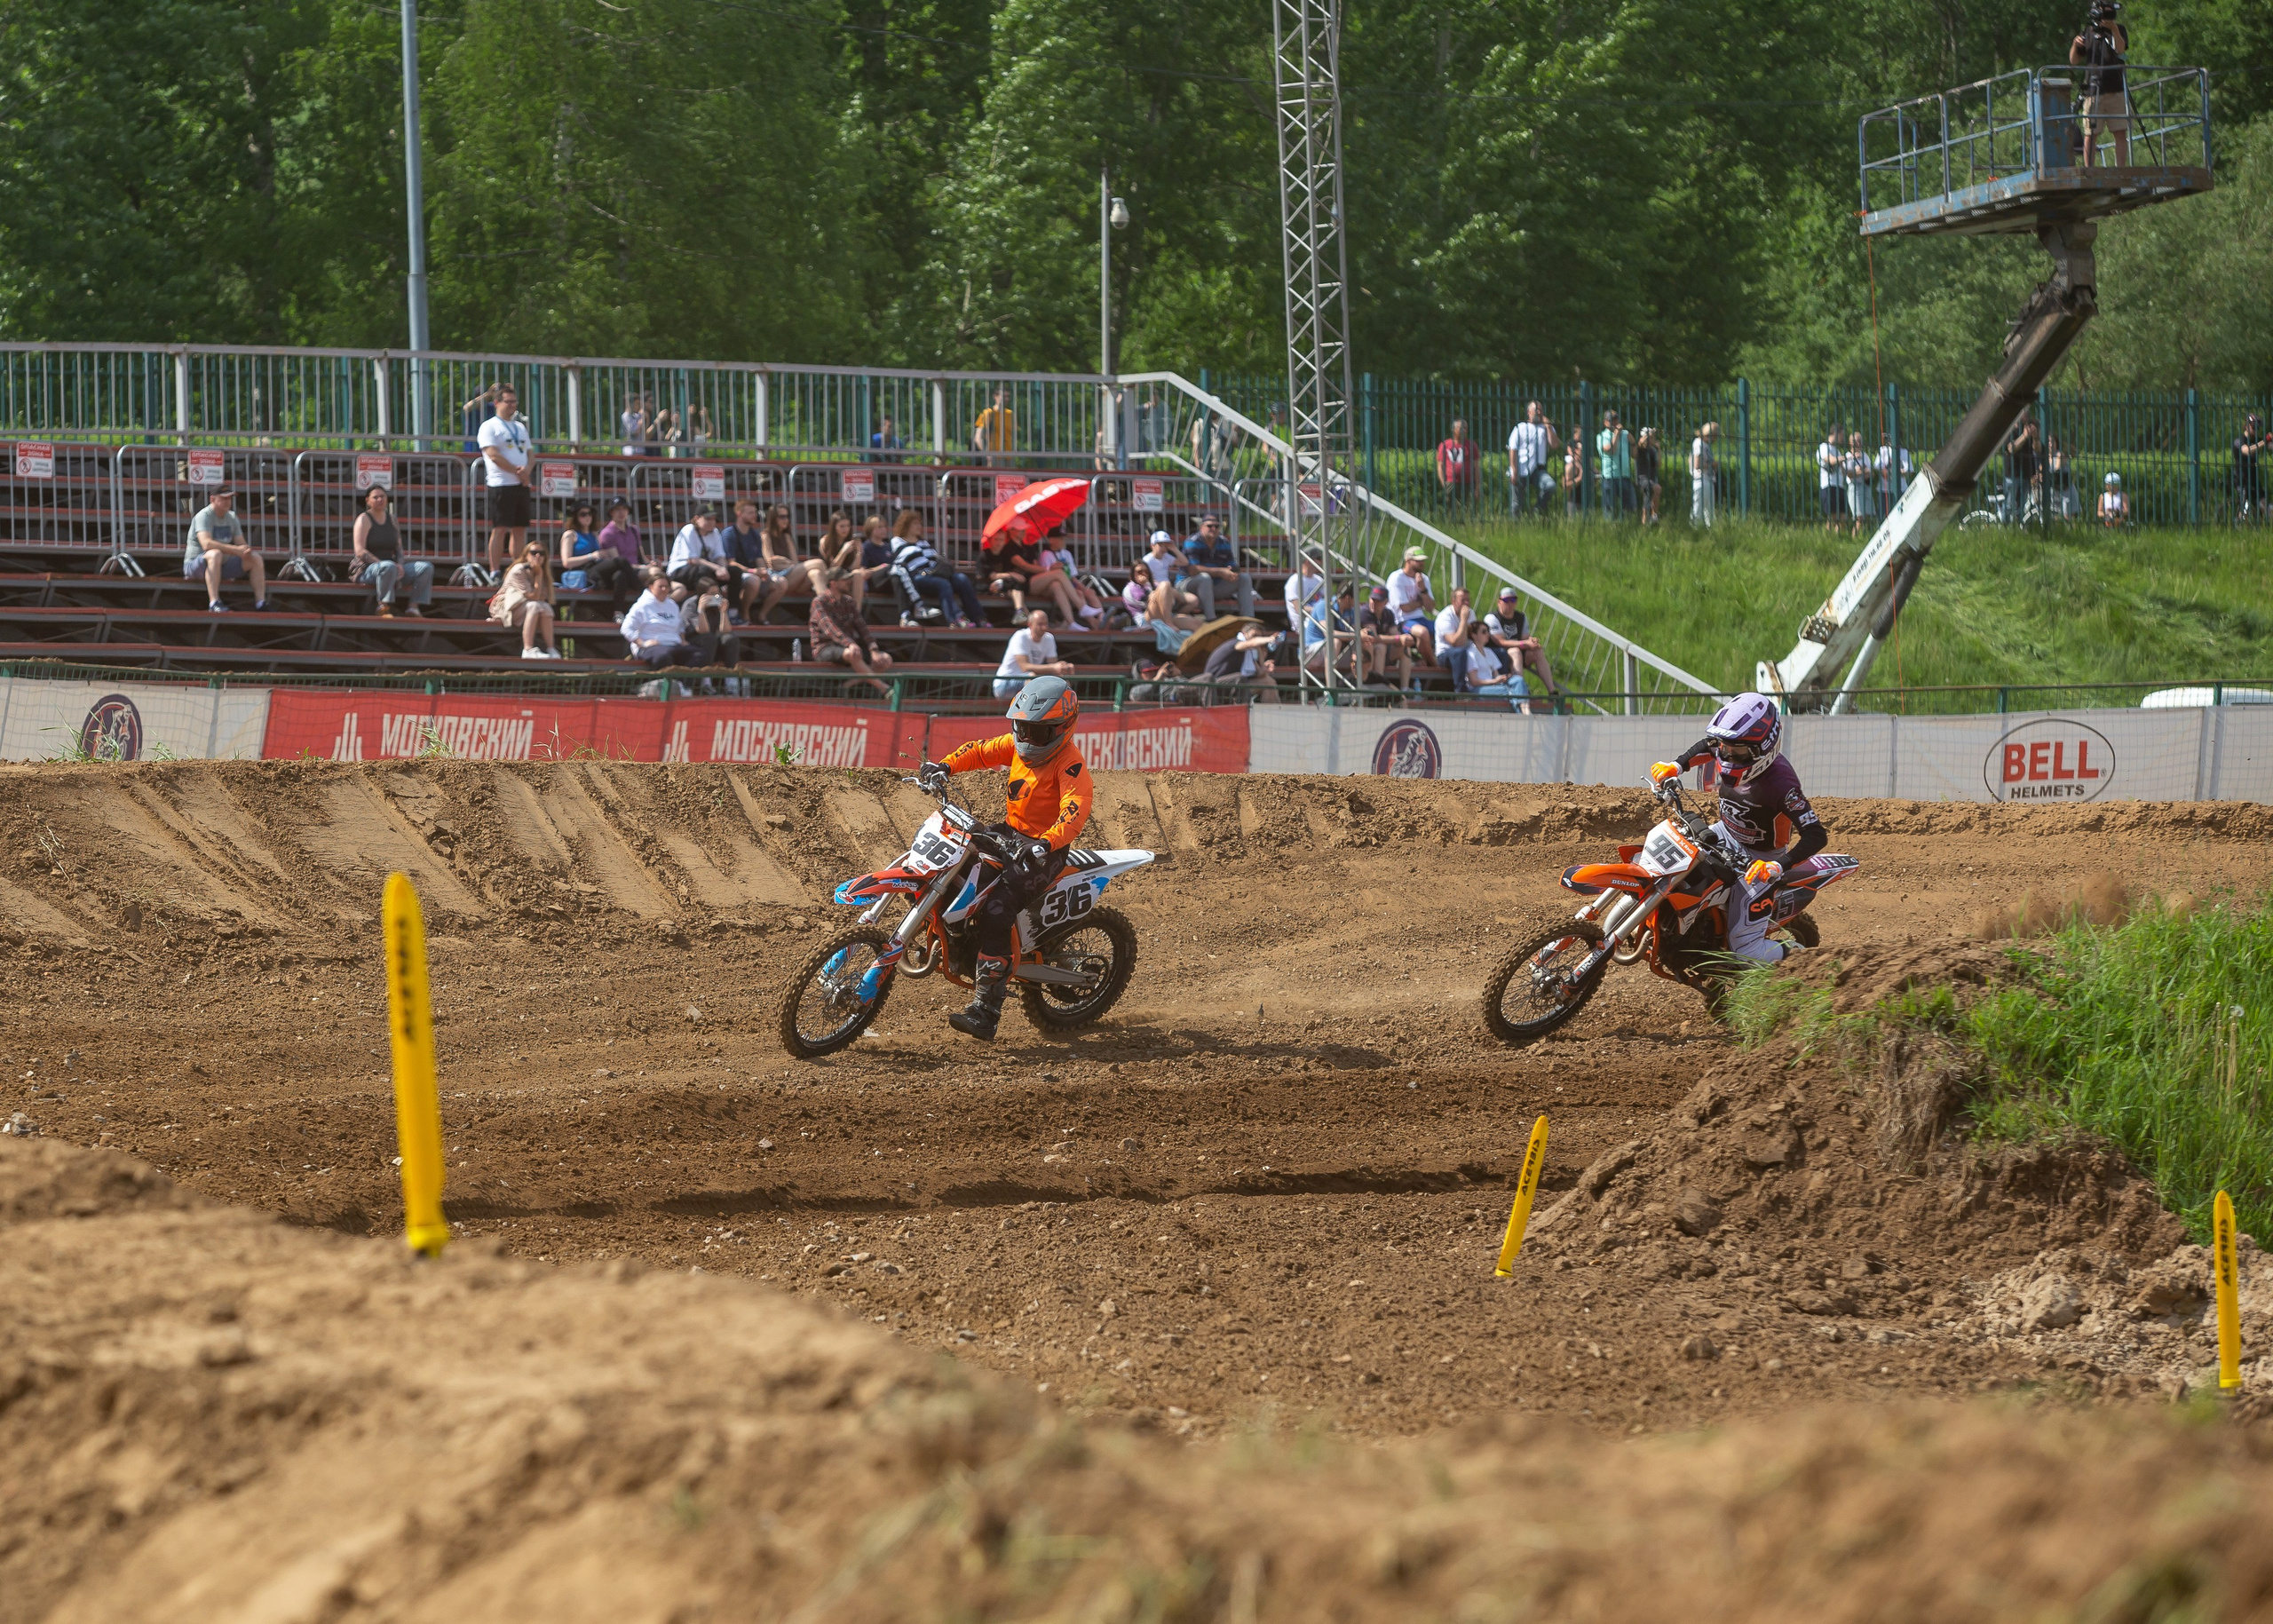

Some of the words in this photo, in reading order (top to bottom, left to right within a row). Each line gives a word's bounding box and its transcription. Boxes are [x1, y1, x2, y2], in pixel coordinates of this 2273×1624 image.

[710, 718, 868, 767] МОСКОВСКИЙ
[1073, 717, 1192, 770] ОСКОВСКИЙ
[2003, 740, 2099, 783] BELL
[2011, 784, 2085, 799] HELMETS
[913, 832, 956, 867] 36
[1644, 834, 1688, 871] 95
[1041, 882, 1093, 927] 36
[1612, 878, 1640, 888] DUNLOP
[1521, 1139, 1540, 1196] ACERBIS
